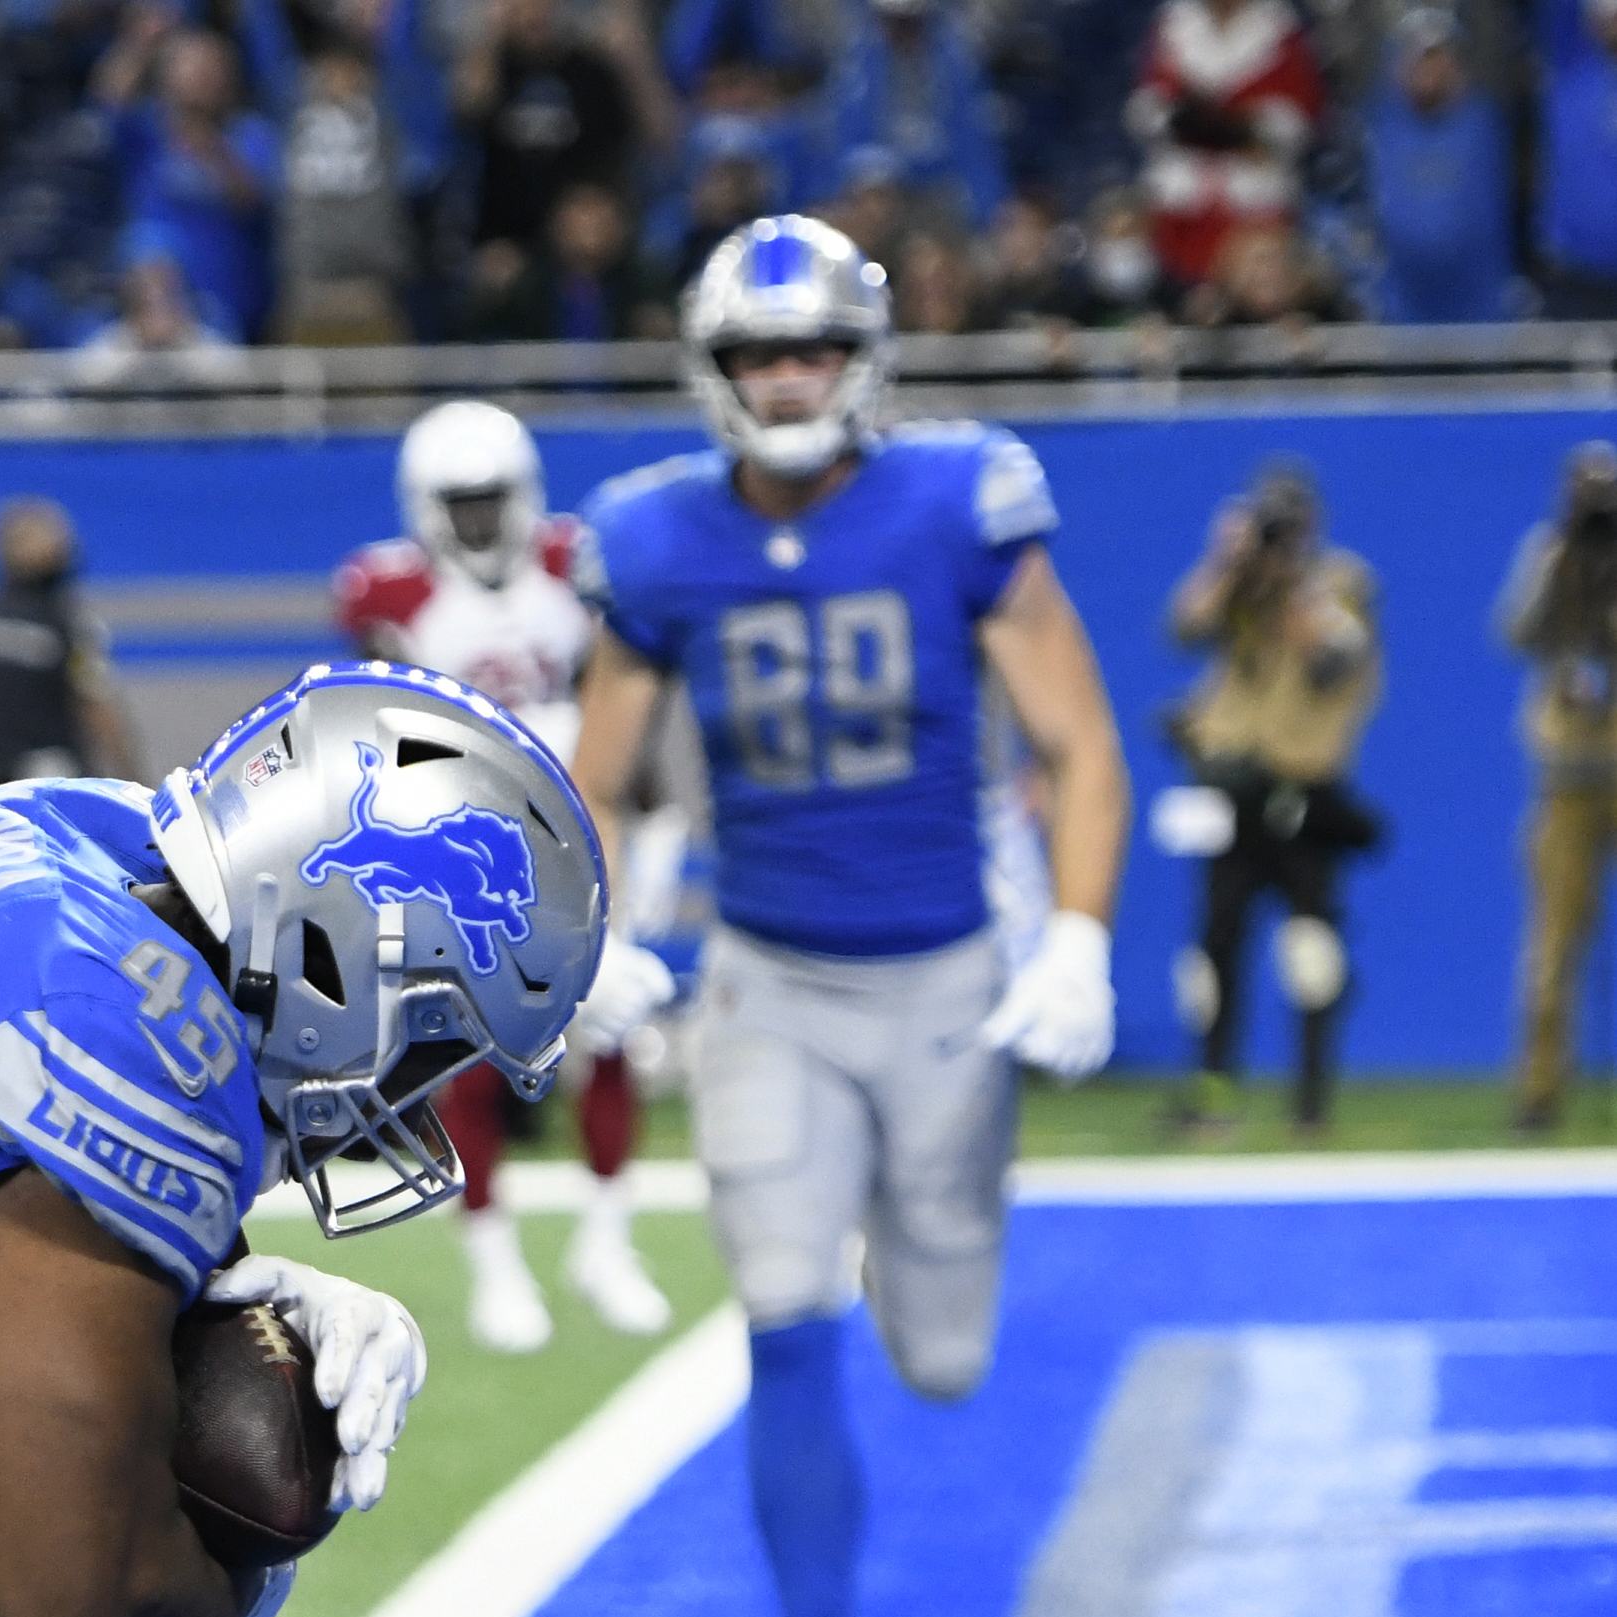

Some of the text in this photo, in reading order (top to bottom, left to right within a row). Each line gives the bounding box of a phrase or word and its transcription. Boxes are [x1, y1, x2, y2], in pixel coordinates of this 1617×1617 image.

[719, 588, 916, 795] 89
[119, 938, 246, 1087] 45
[26, 1087, 203, 1216] LIONS
